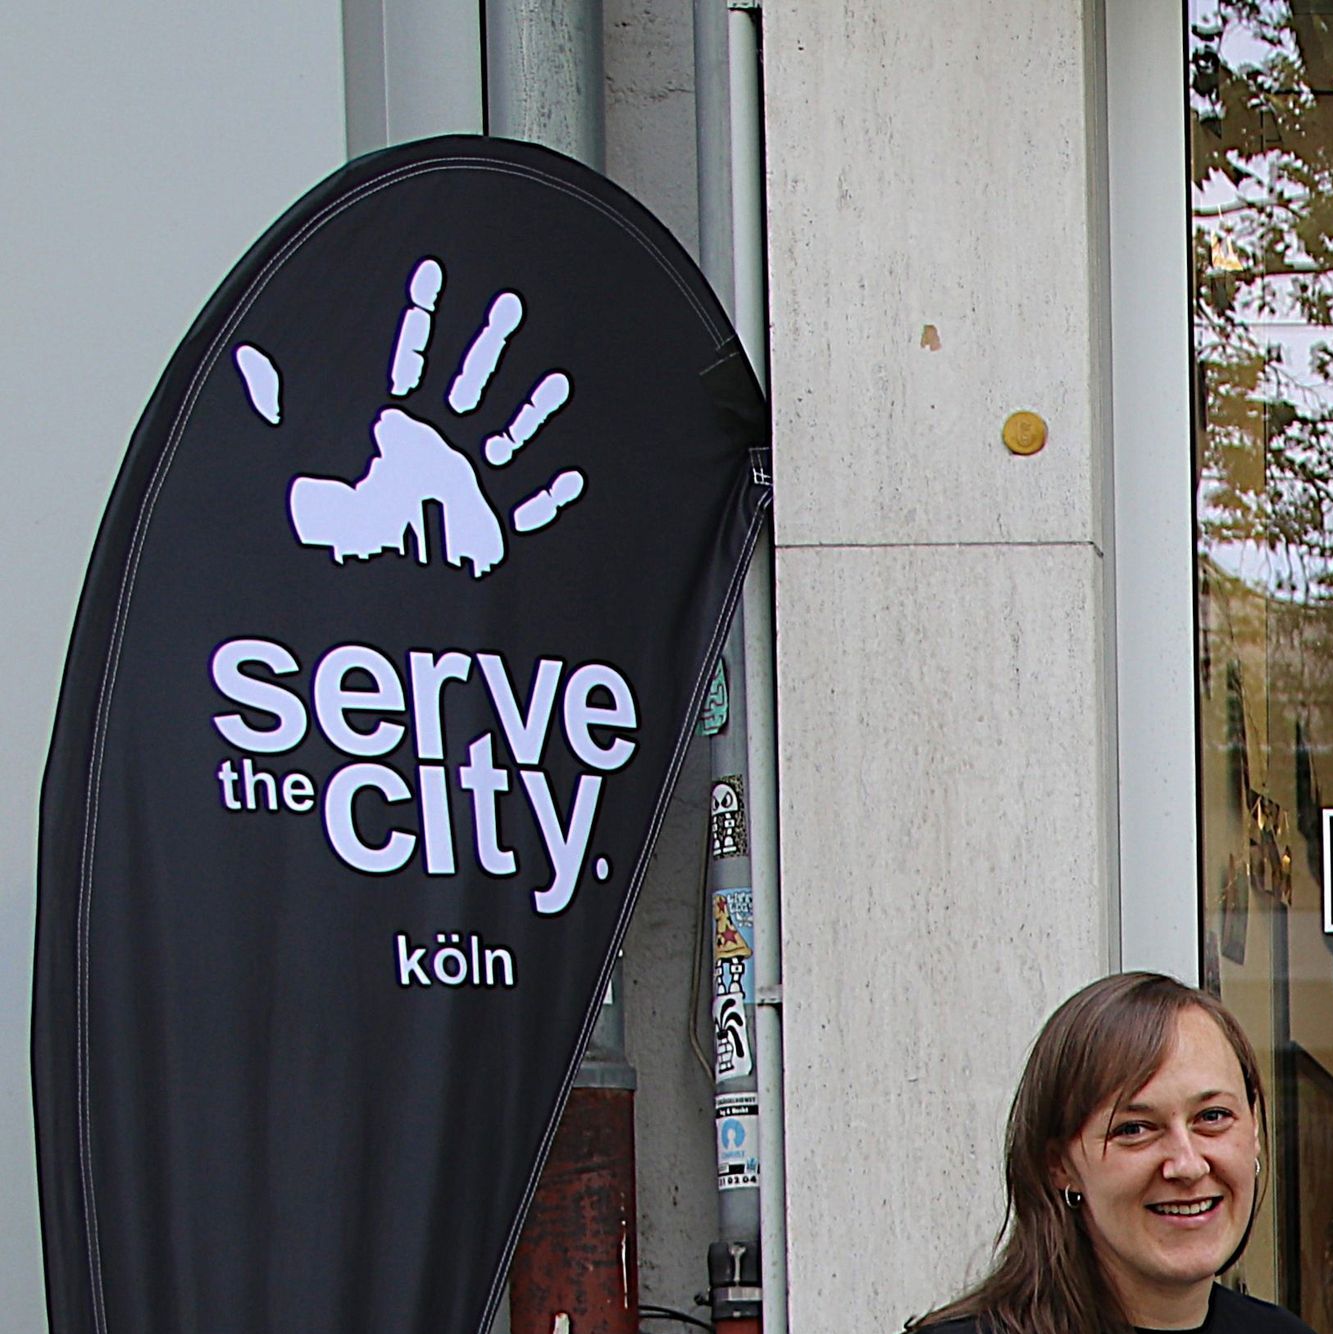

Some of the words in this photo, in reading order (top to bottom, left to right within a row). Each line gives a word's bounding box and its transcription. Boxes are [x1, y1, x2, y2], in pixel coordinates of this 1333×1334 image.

[211, 637, 638, 770] serve
[218, 759, 315, 812] the
[323, 730, 610, 915] city.
[396, 934, 514, 986] köln
